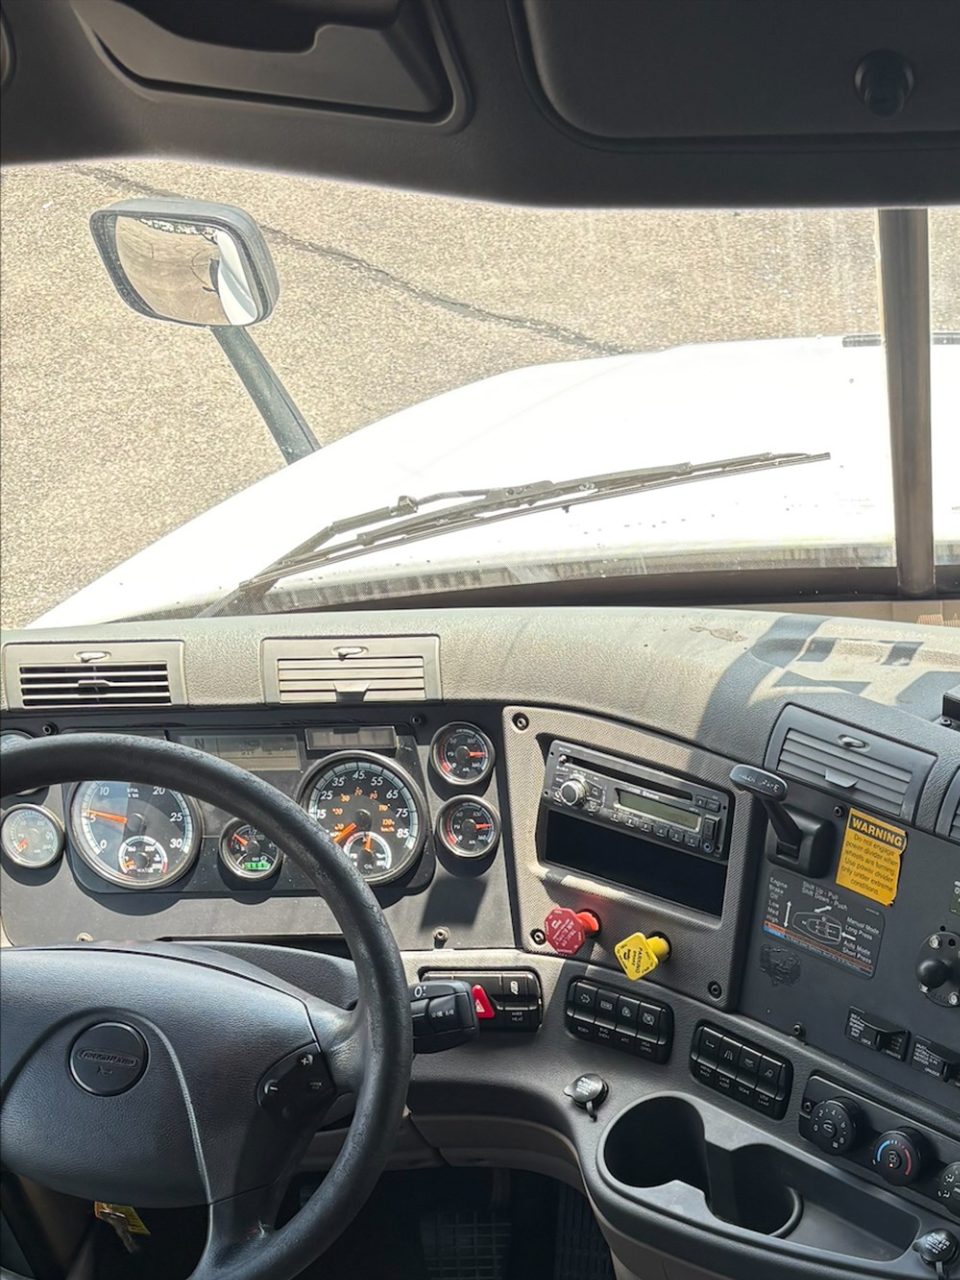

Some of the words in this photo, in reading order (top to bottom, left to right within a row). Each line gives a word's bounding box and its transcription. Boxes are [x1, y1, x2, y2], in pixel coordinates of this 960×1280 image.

[353, 770, 365, 778] 45
[332, 777, 345, 786] 35
[370, 777, 383, 786] 55
[99, 786, 110, 796] 10
[152, 786, 166, 795] 20
[386, 790, 398, 799] 65
[320, 791, 333, 800] 25
[169, 812, 183, 822] 25
[316, 808, 327, 819] 15
[395, 808, 408, 817] 75
[396, 829, 409, 838] 85
[851, 817, 903, 847] WARNING
[100, 839, 108, 849] 0
[169, 838, 183, 849] 30
